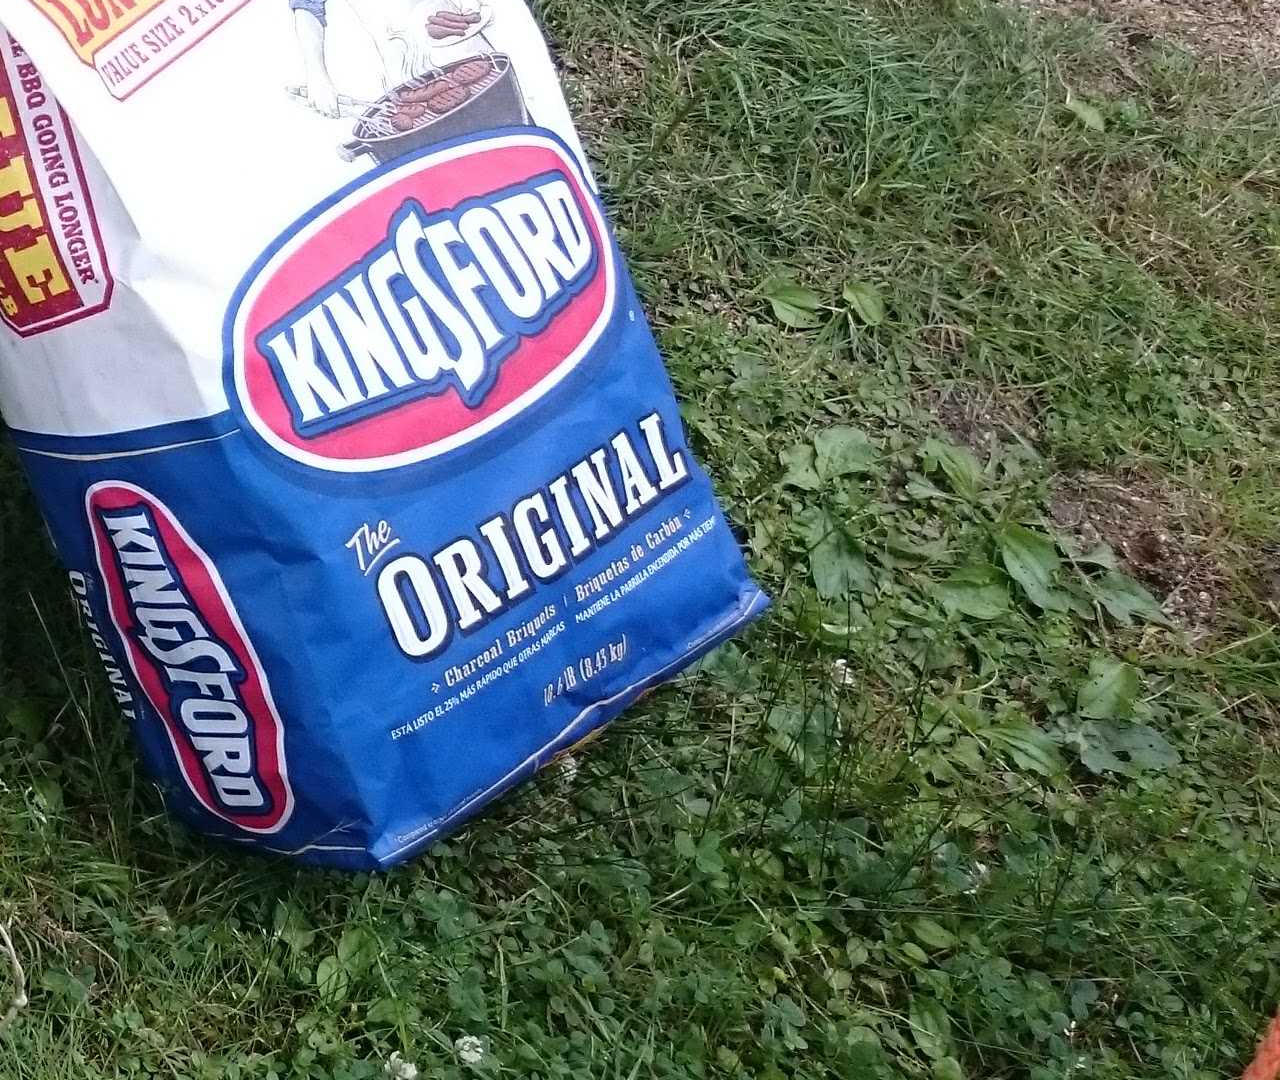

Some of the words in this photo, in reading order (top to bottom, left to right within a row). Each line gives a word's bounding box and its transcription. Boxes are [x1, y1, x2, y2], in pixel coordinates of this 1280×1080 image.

[100, 40, 149, 88] VALUE
[143, 14, 184, 55] SIZE
[15, 62, 46, 110] BBQ
[31, 113, 68, 190] GOING
[50, 191, 99, 286] LONGER
[268, 178, 593, 424] KINGSFORD
[344, 519, 393, 570] The
[374, 413, 690, 659] ORIGINAL
[412, 710, 435, 731] LISTO
[435, 705, 445, 718] EL
[502, 658, 519, 674] QUE
[518, 640, 541, 663] OTRAS
[540, 621, 567, 648] MARCAS
[575, 594, 612, 624] MANTIENE
[610, 588, 621, 602] LA
[678, 537, 691, 554] POR
[444, 639, 504, 688] Charcoal
[506, 604, 557, 648] Briquets
[574, 556, 630, 603] Briquetas
[630, 544, 645, 563] de
[101, 510, 266, 809] KINGSFORD
